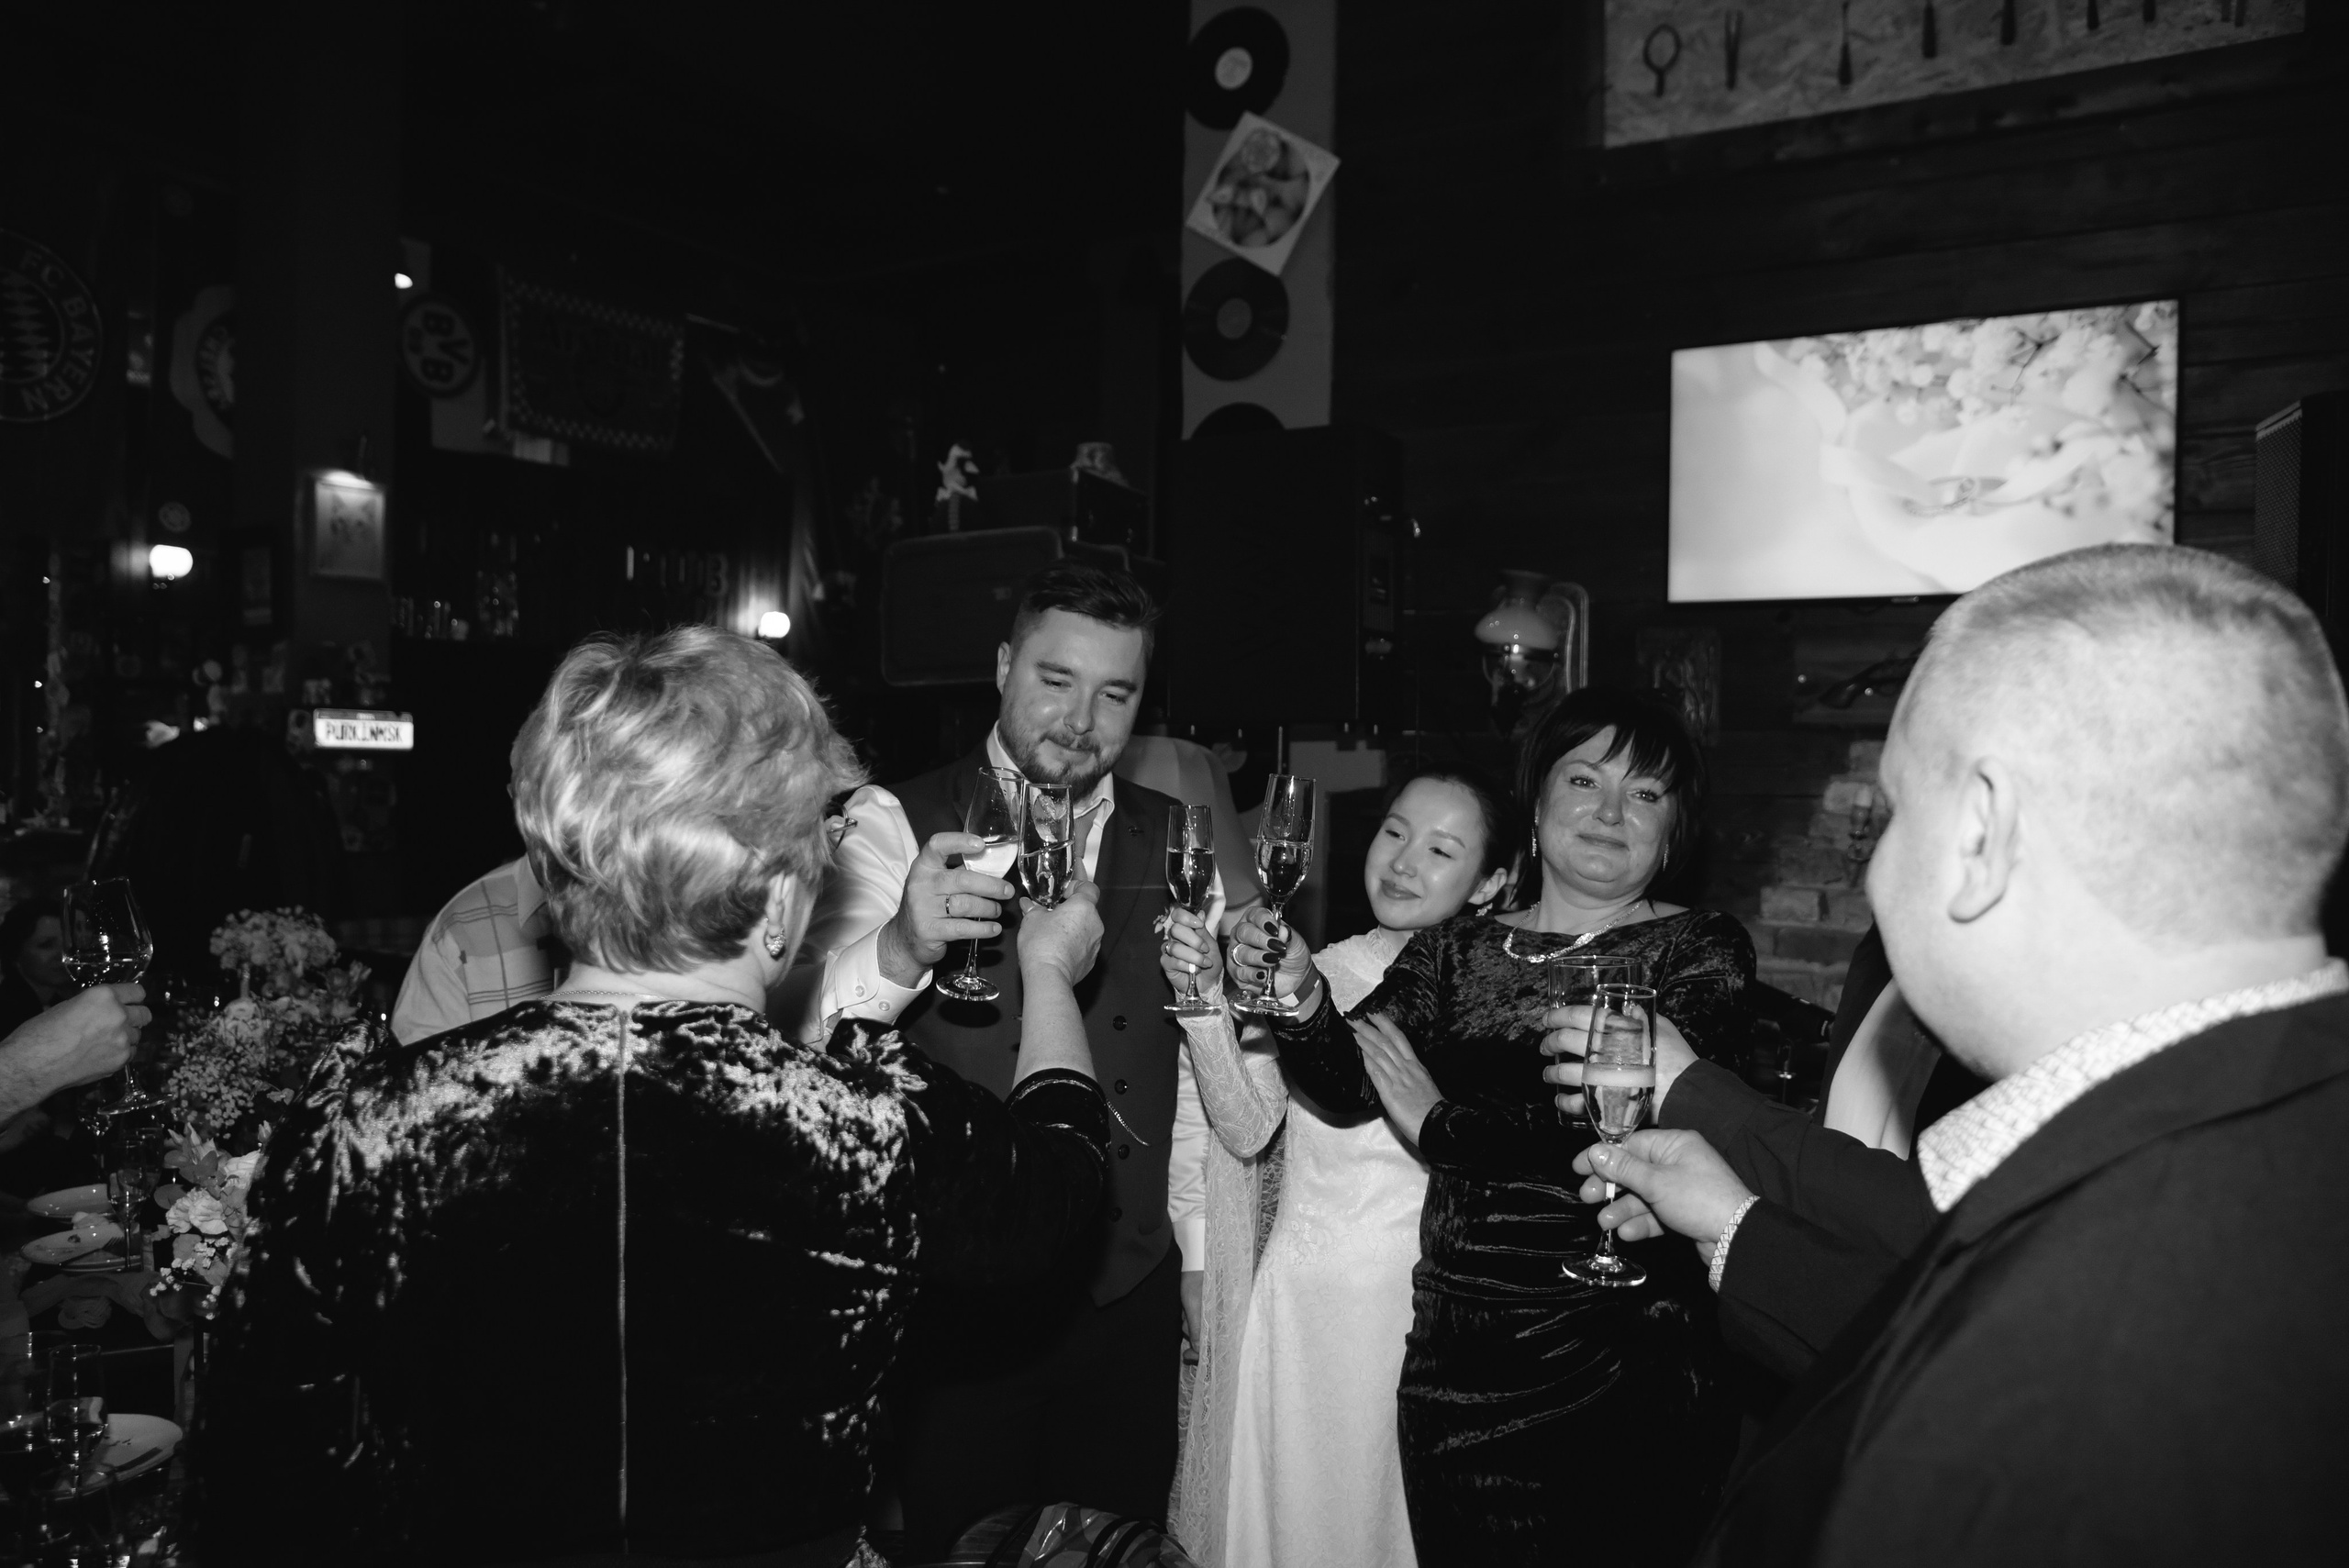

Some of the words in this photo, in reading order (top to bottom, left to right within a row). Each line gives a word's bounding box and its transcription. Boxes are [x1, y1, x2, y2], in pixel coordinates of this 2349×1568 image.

[19, 250, 64, 289] FC
[20, 295, 95, 413] BAYERN
[421, 310, 470, 384] BVB
